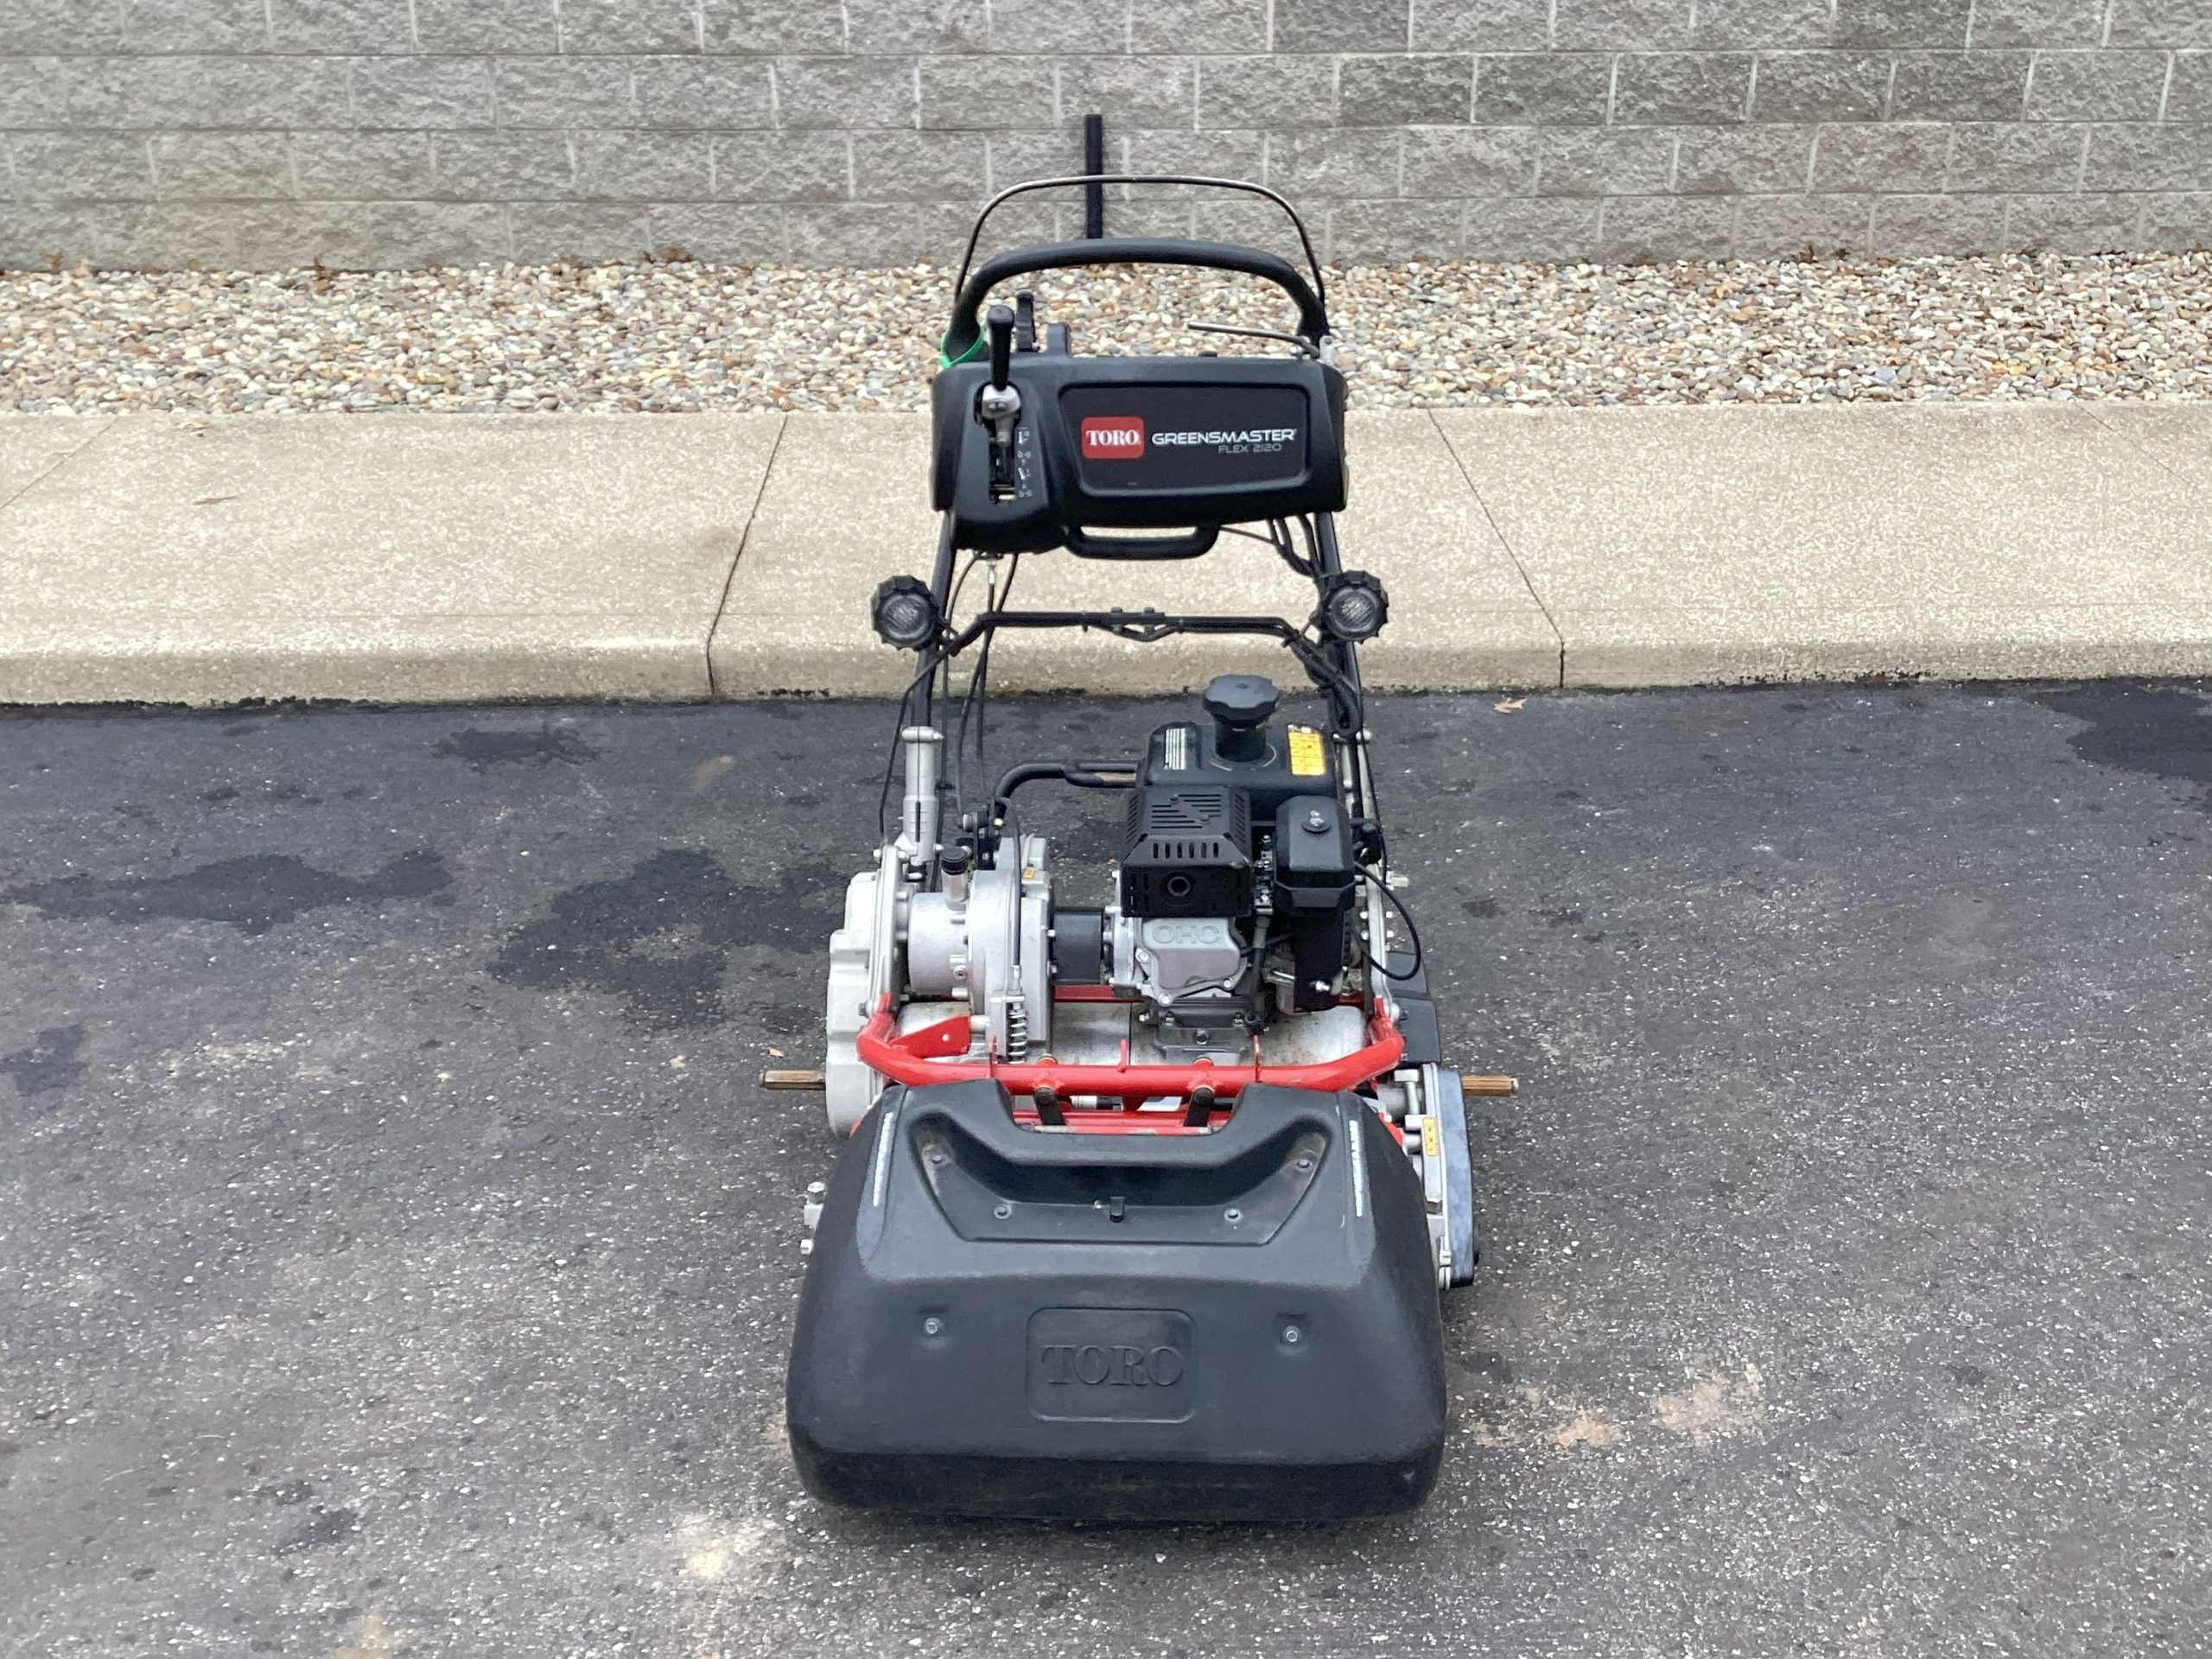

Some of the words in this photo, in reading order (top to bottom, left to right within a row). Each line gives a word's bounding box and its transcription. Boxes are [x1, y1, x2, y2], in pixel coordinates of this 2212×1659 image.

[1086, 430, 1140, 446] TORO
[1152, 429, 1295, 445] GREENSMASTER
[1218, 444, 1249, 454] FLEX
[1253, 443, 1282, 453] 2120
[1152, 925, 1220, 944] OHC
[1041, 1344, 1184, 1387] TORO
